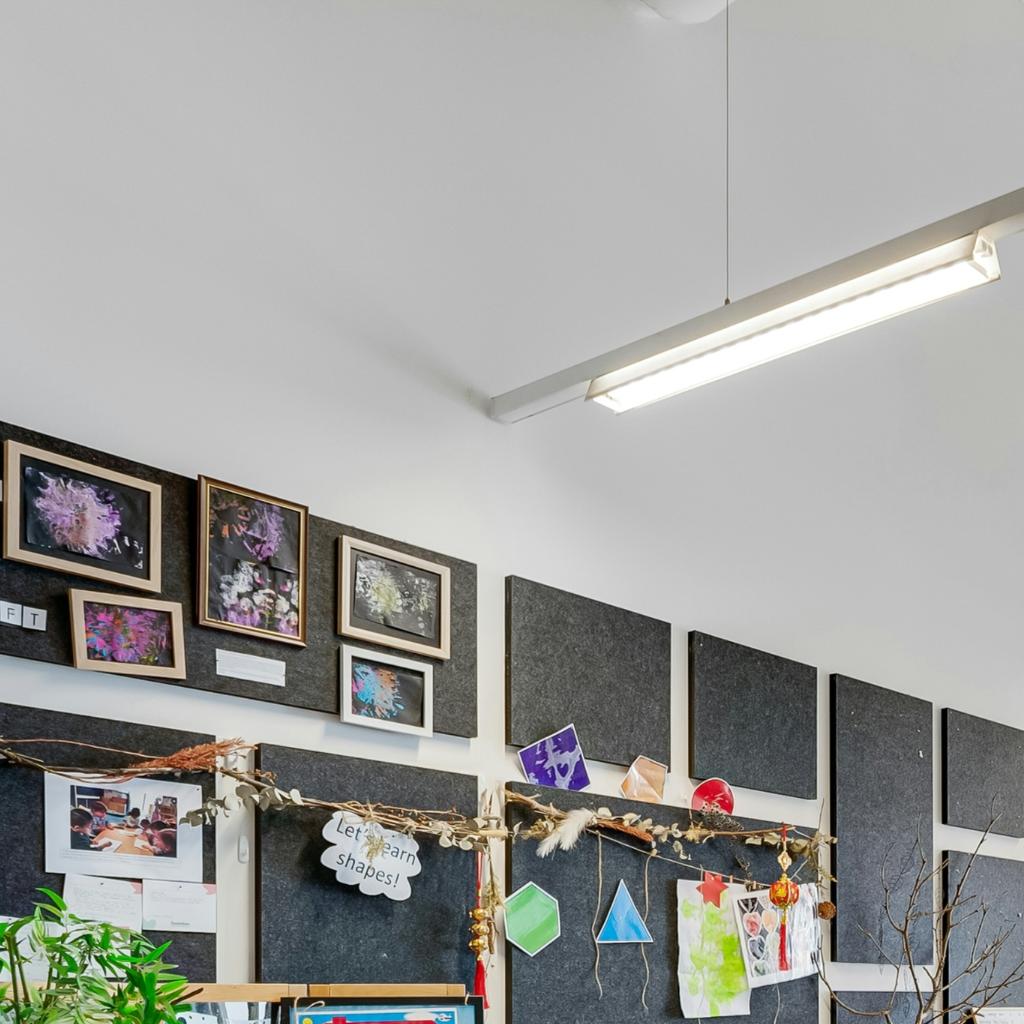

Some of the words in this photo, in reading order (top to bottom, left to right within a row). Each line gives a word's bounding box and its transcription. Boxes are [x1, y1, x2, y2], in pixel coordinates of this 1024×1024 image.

[336, 818, 373, 841] Let'
[380, 838, 416, 866] earn
[336, 852, 400, 888] shapes!
